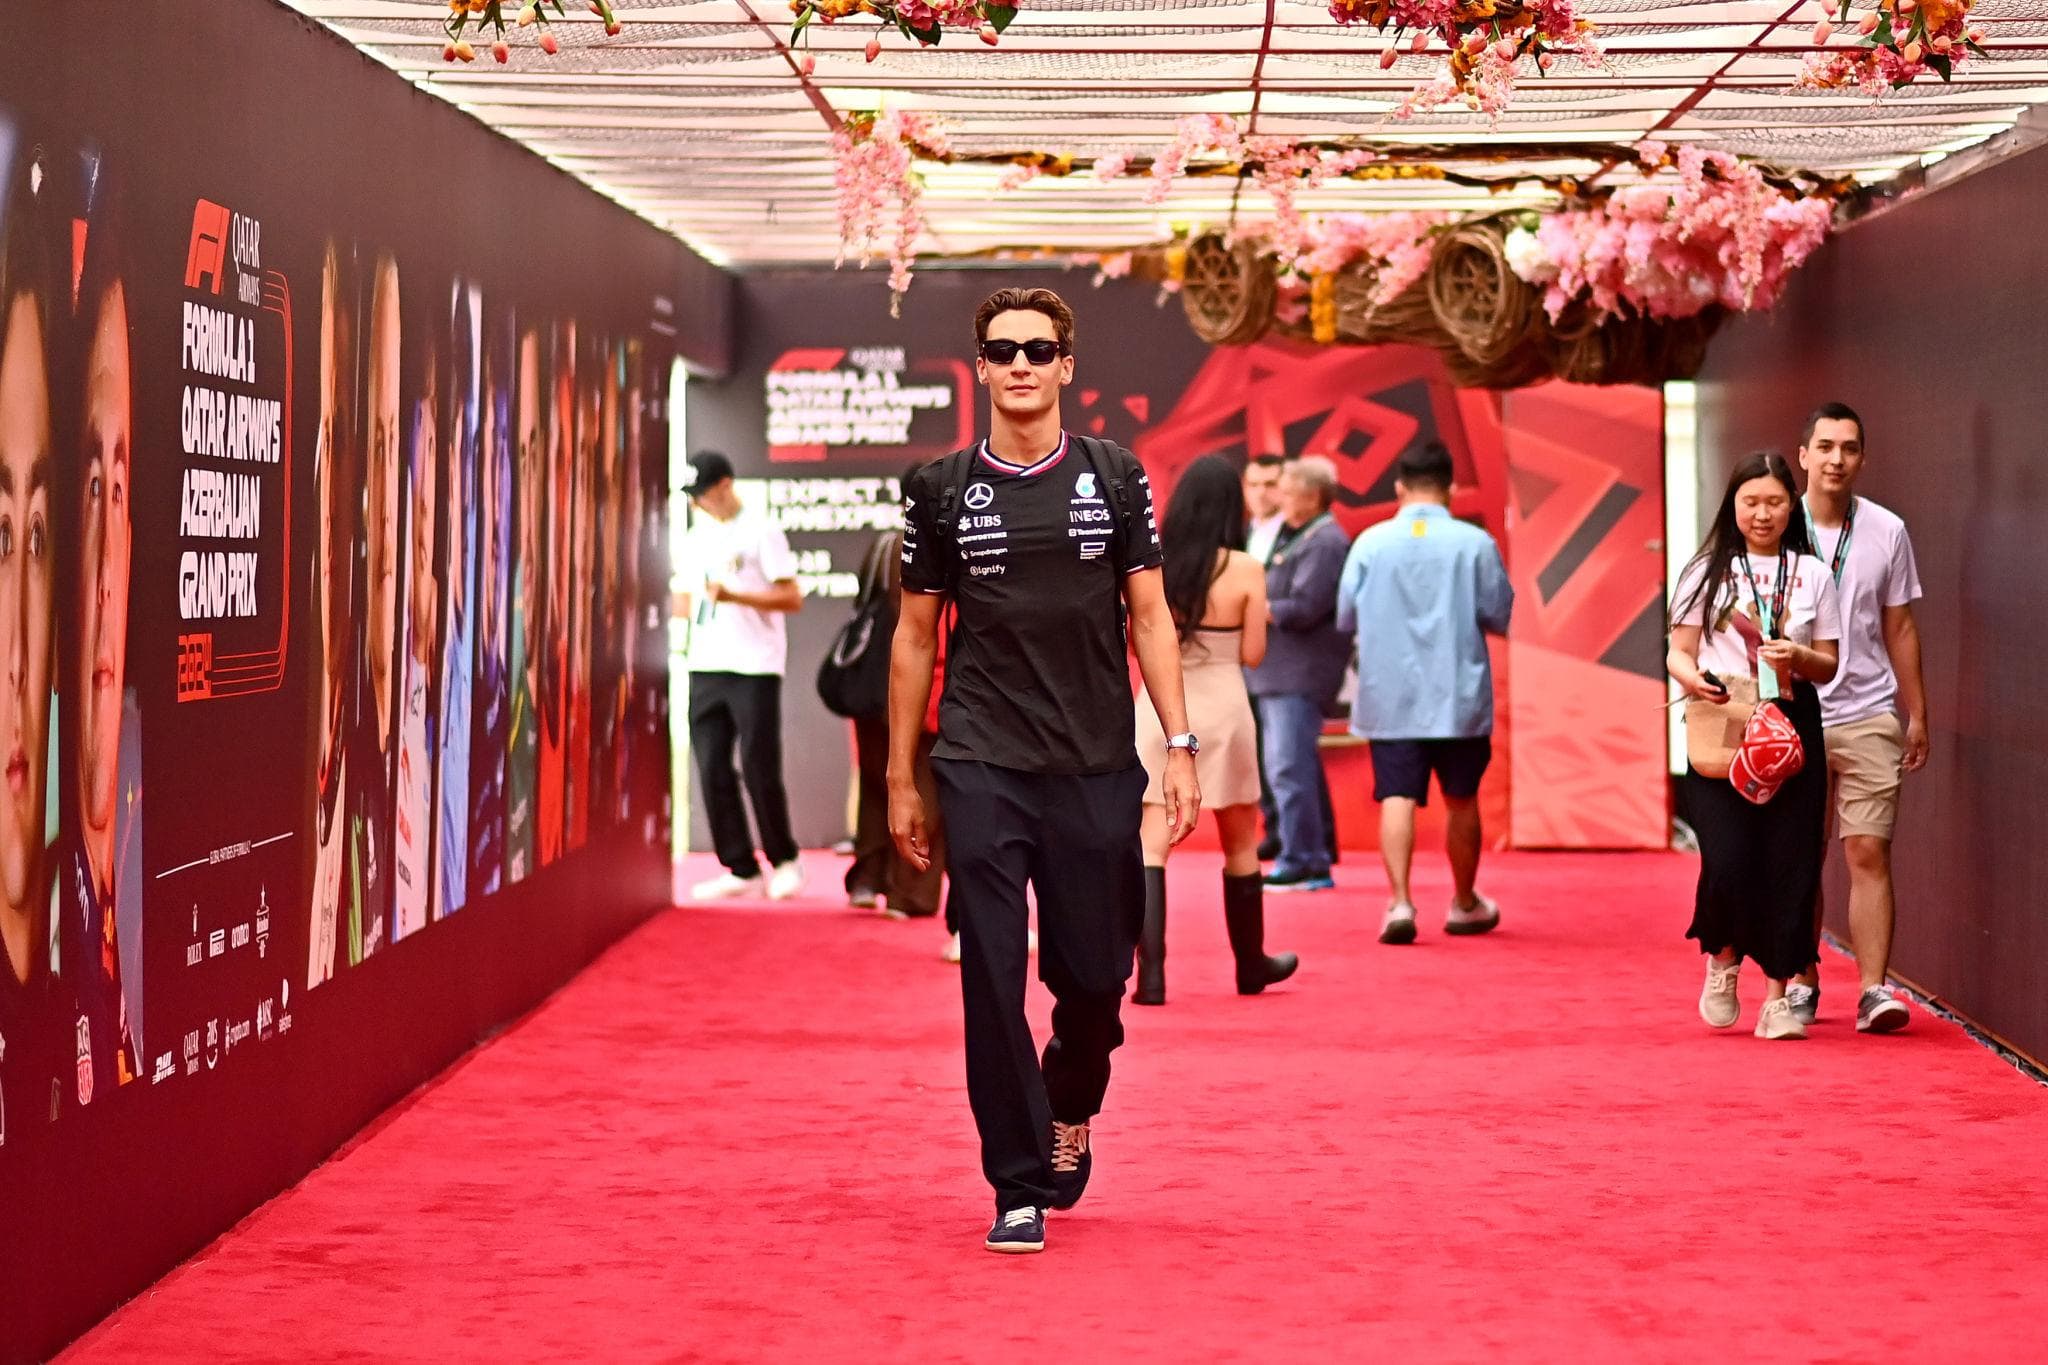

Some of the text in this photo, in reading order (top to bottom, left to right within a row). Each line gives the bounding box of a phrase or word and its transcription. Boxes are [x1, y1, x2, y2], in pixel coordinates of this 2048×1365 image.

[232, 212, 260, 274] QATAR
[182, 301, 256, 384] FORMULA 1
[181, 385, 281, 463] QATAR AIRWAYS
[179, 468, 260, 538] AZERBAIJAN
[769, 478, 881, 504] EXPECT
[973, 514, 1002, 528] UBS
[1069, 508, 1111, 523] INEOS
[1077, 527, 1114, 536] TeamViewer
[970, 547, 1008, 557] Snapdragon
[178, 551, 258, 619] GRAND PRIX
